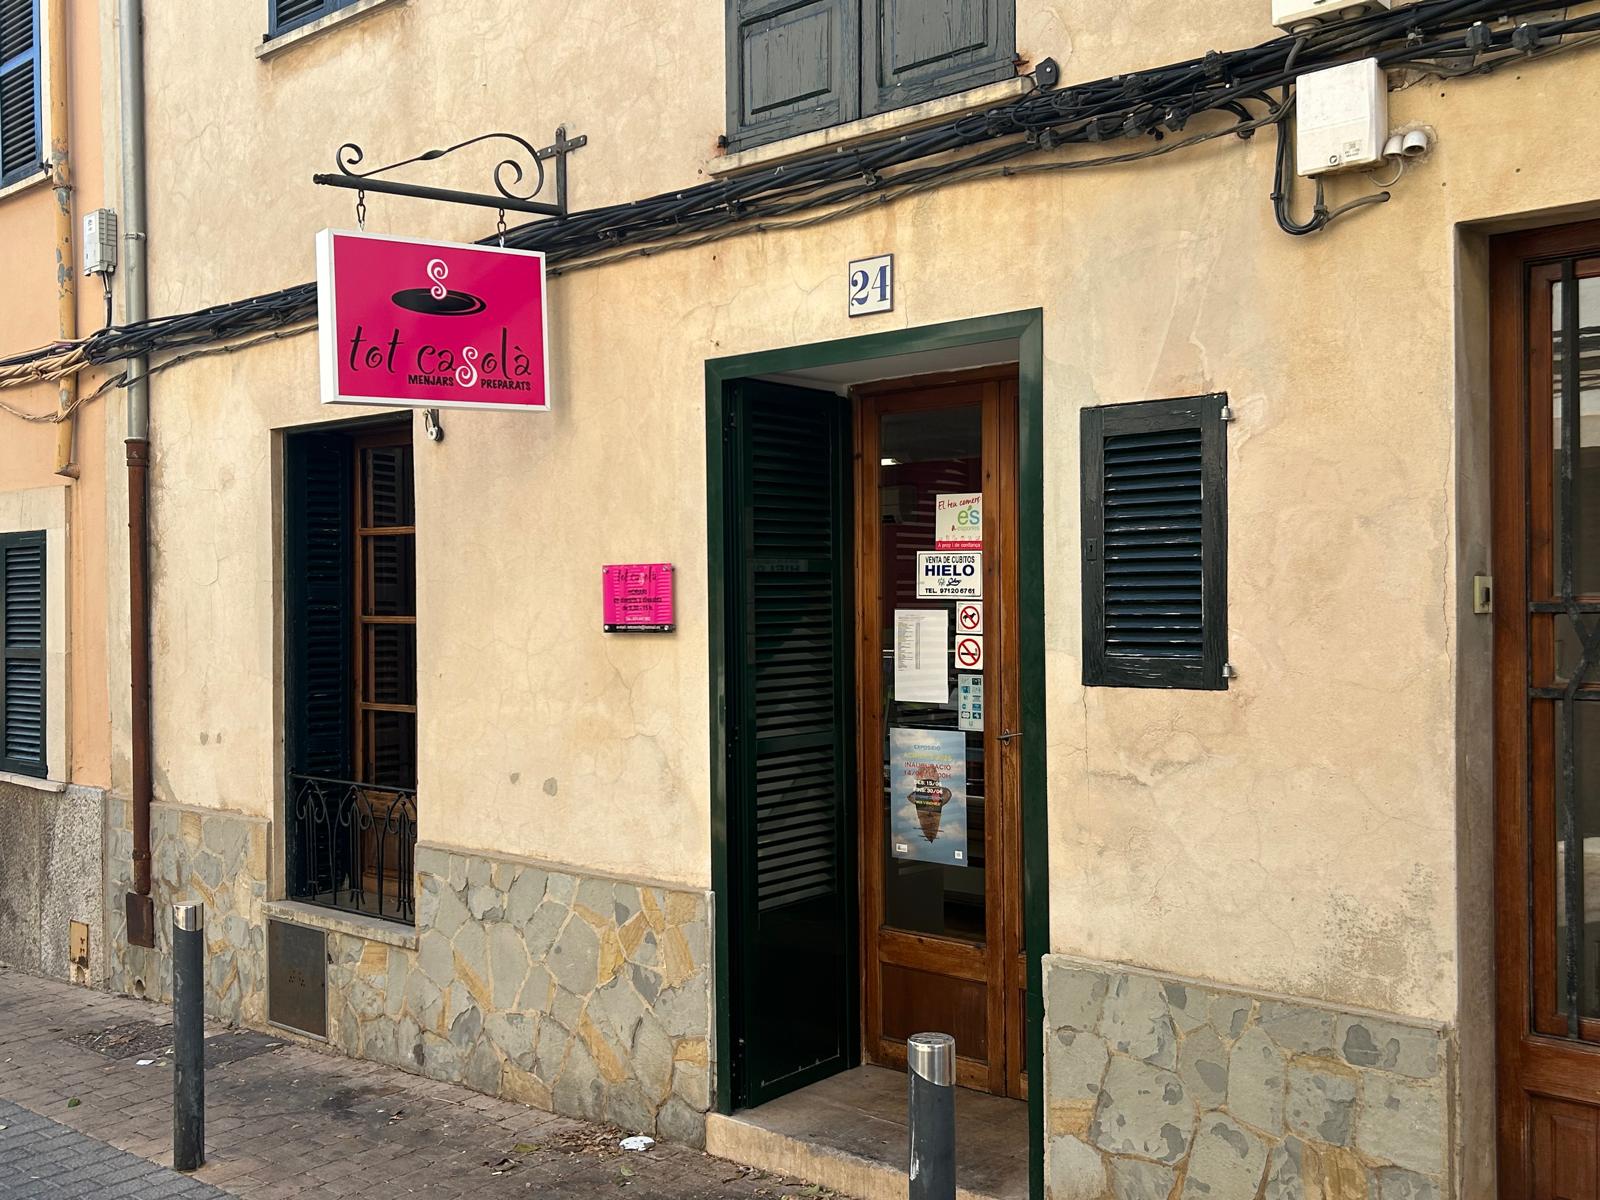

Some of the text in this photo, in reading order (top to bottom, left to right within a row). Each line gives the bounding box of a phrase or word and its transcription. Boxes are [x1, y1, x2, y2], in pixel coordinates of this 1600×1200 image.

[850, 264, 889, 306] 24
[350, 325, 532, 388] tot casolà
[407, 374, 531, 391] MENJARS PREPARATS
[957, 505, 980, 525] és
[925, 556, 975, 564] VENTA DE CUBITOS
[925, 564, 975, 576] HIELO
